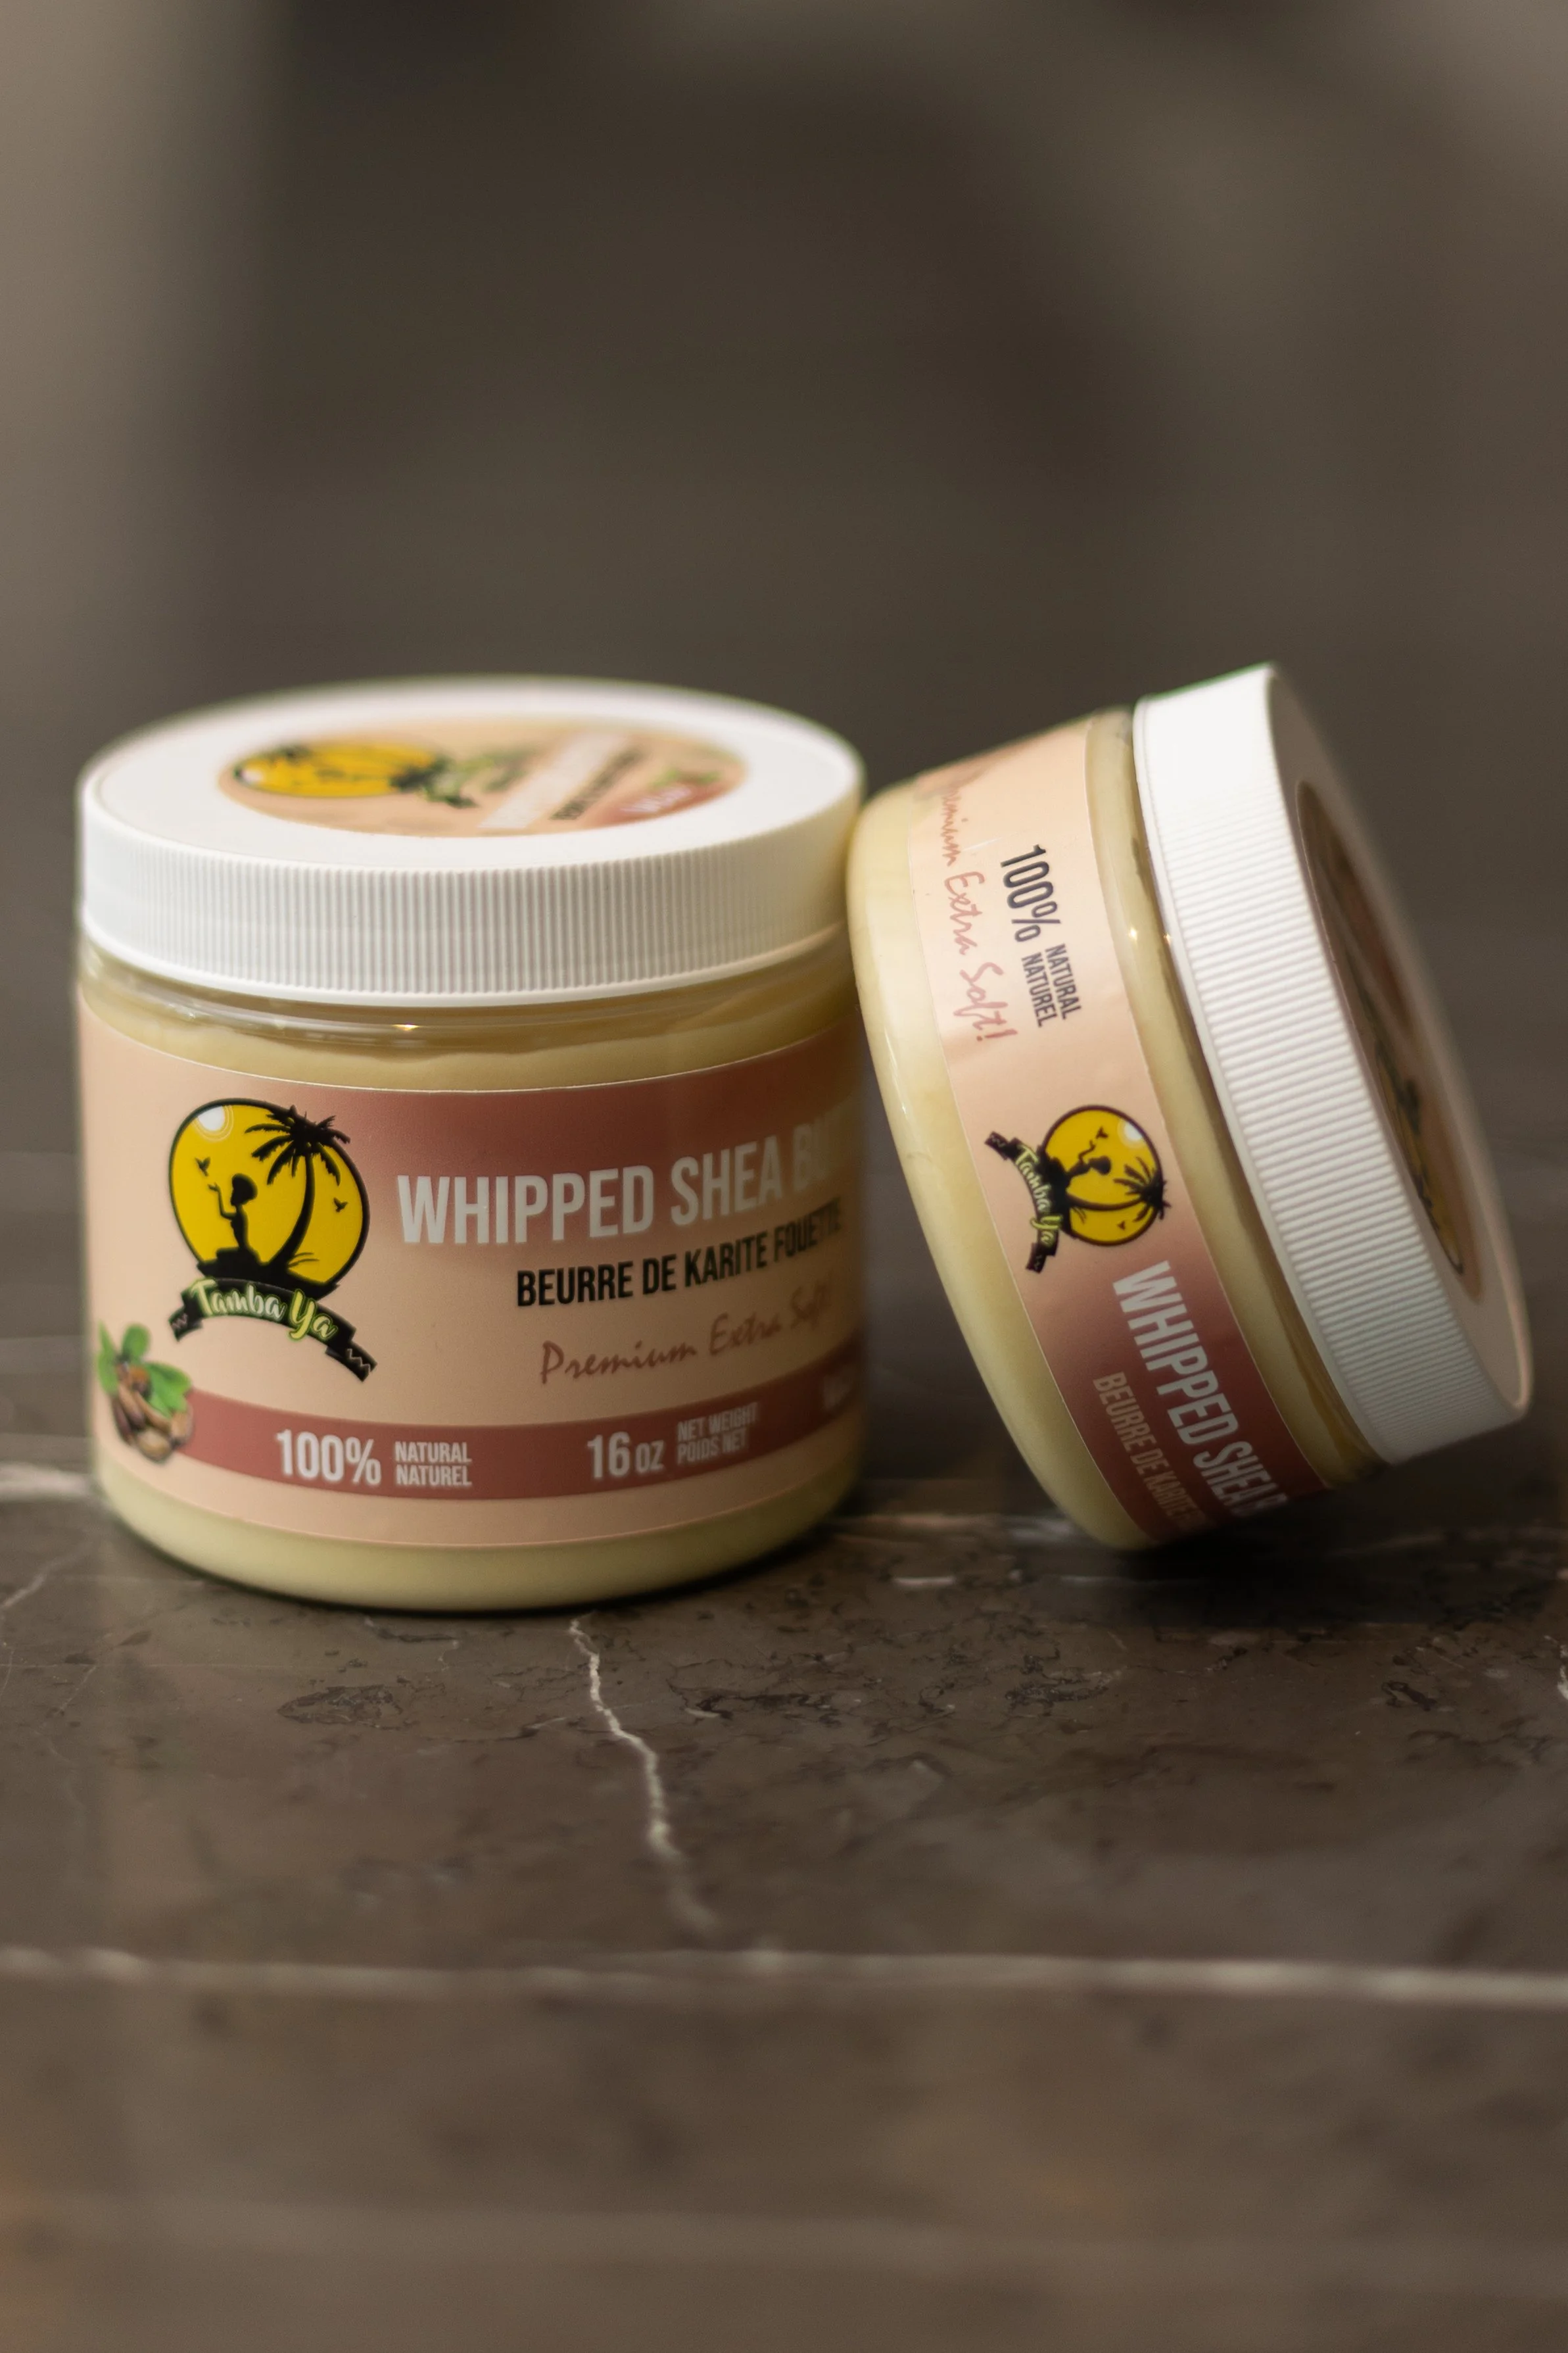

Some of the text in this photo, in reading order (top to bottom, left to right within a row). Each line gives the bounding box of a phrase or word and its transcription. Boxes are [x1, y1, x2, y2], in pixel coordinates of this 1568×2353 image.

[944, 871, 985, 955] Extra
[1000, 843, 1060, 942] 100%
[953, 961, 1018, 1042] Soft!
[1021, 952, 1058, 1027] NATUREL
[1045, 943, 1082, 1019] NATURAL
[397, 1164, 655, 1245] WHIPPED
[671, 1135, 782, 1227] SHEA
[1015, 1144, 1052, 1214] Tamba
[516, 1261, 634, 1307] BEURRE
[642, 1253, 677, 1295] DE
[684, 1230, 768, 1288] KARITE
[191, 1278, 338, 1342] Tamba Ya
[540, 1340, 696, 1384] Premium
[709, 1312, 782, 1357] Extra
[1112, 1260, 1239, 1445] WHIPPED
[276, 1428, 381, 1486] 100%
[395, 1442, 472, 1464] NATURAL
[587, 1431, 630, 1480] 16
[677, 1401, 759, 1442] NET WEIGHT
[677, 1428, 748, 1465] POIDS NET
[1093, 1372, 1157, 1452] BEURRE
[1130, 1448, 1170, 1476] DE
[396, 1464, 472, 1487] NATUREL
